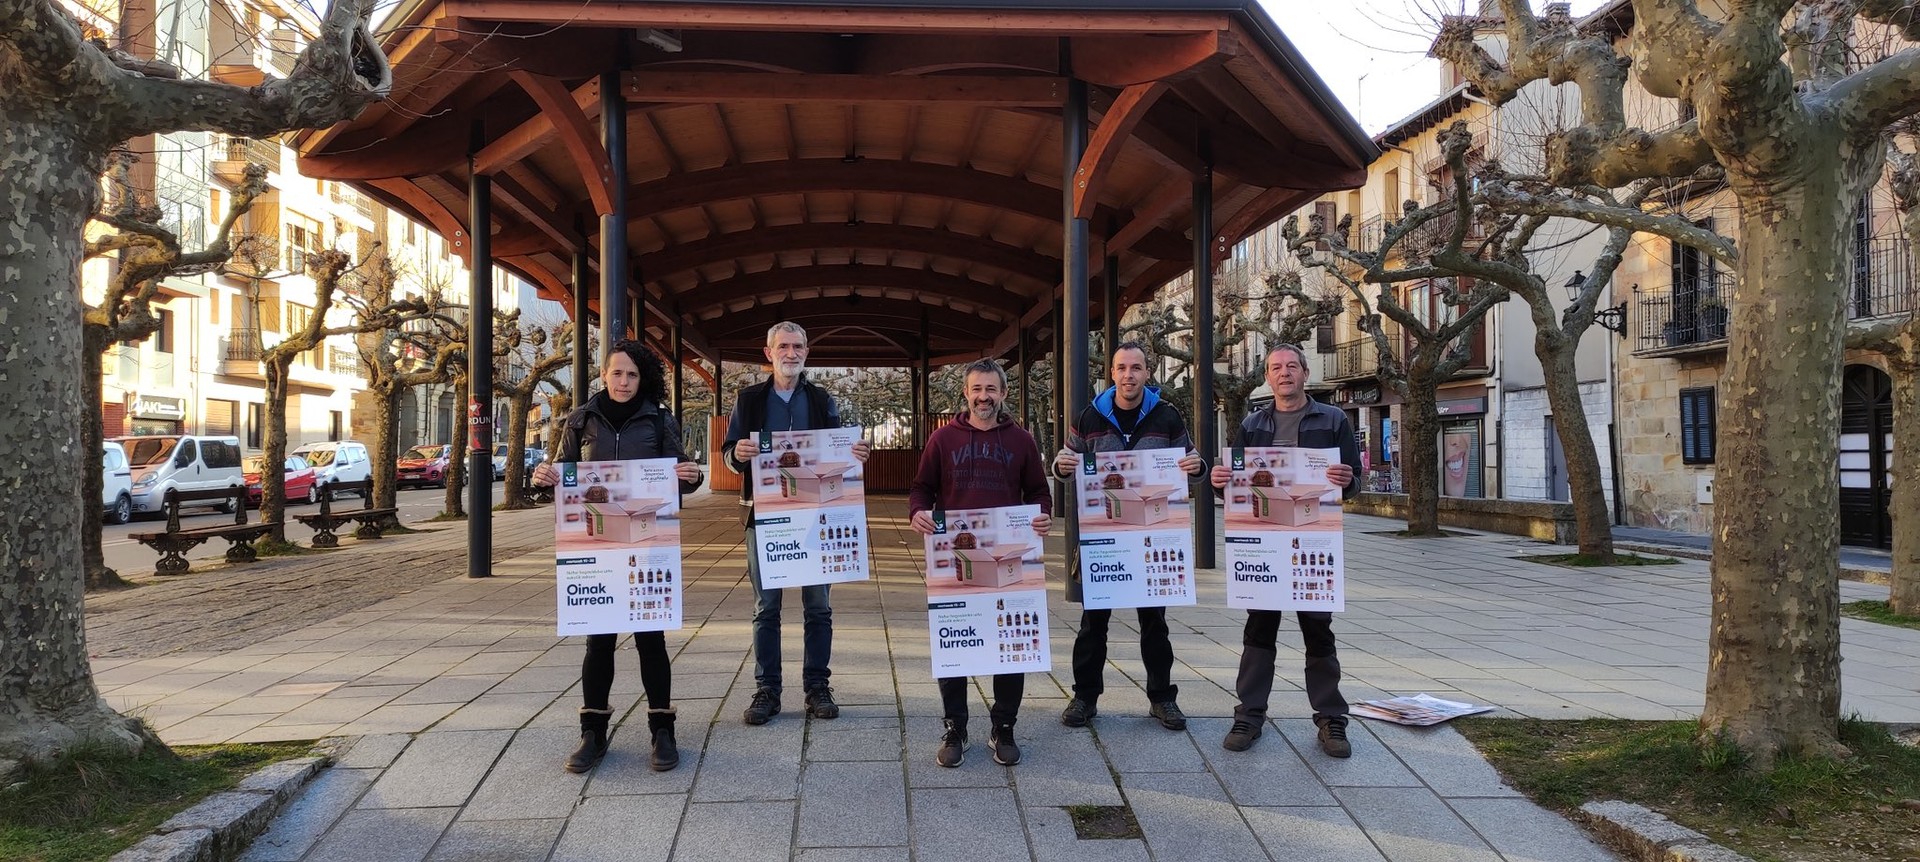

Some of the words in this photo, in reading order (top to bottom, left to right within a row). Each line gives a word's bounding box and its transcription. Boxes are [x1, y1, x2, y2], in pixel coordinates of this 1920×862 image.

[951, 441, 1014, 466] VALLEY
[765, 540, 801, 552] Oinak
[766, 551, 808, 562] lurrean
[1089, 561, 1125, 573] Oinak
[1234, 561, 1270, 573] Oinak
[1090, 573, 1133, 583] lurrean
[1235, 571, 1278, 583] lurrean
[566, 582, 606, 595] Oinak
[567, 595, 614, 606] lurrean
[939, 625, 977, 638] Oinak
[939, 638, 984, 649] lurrean
